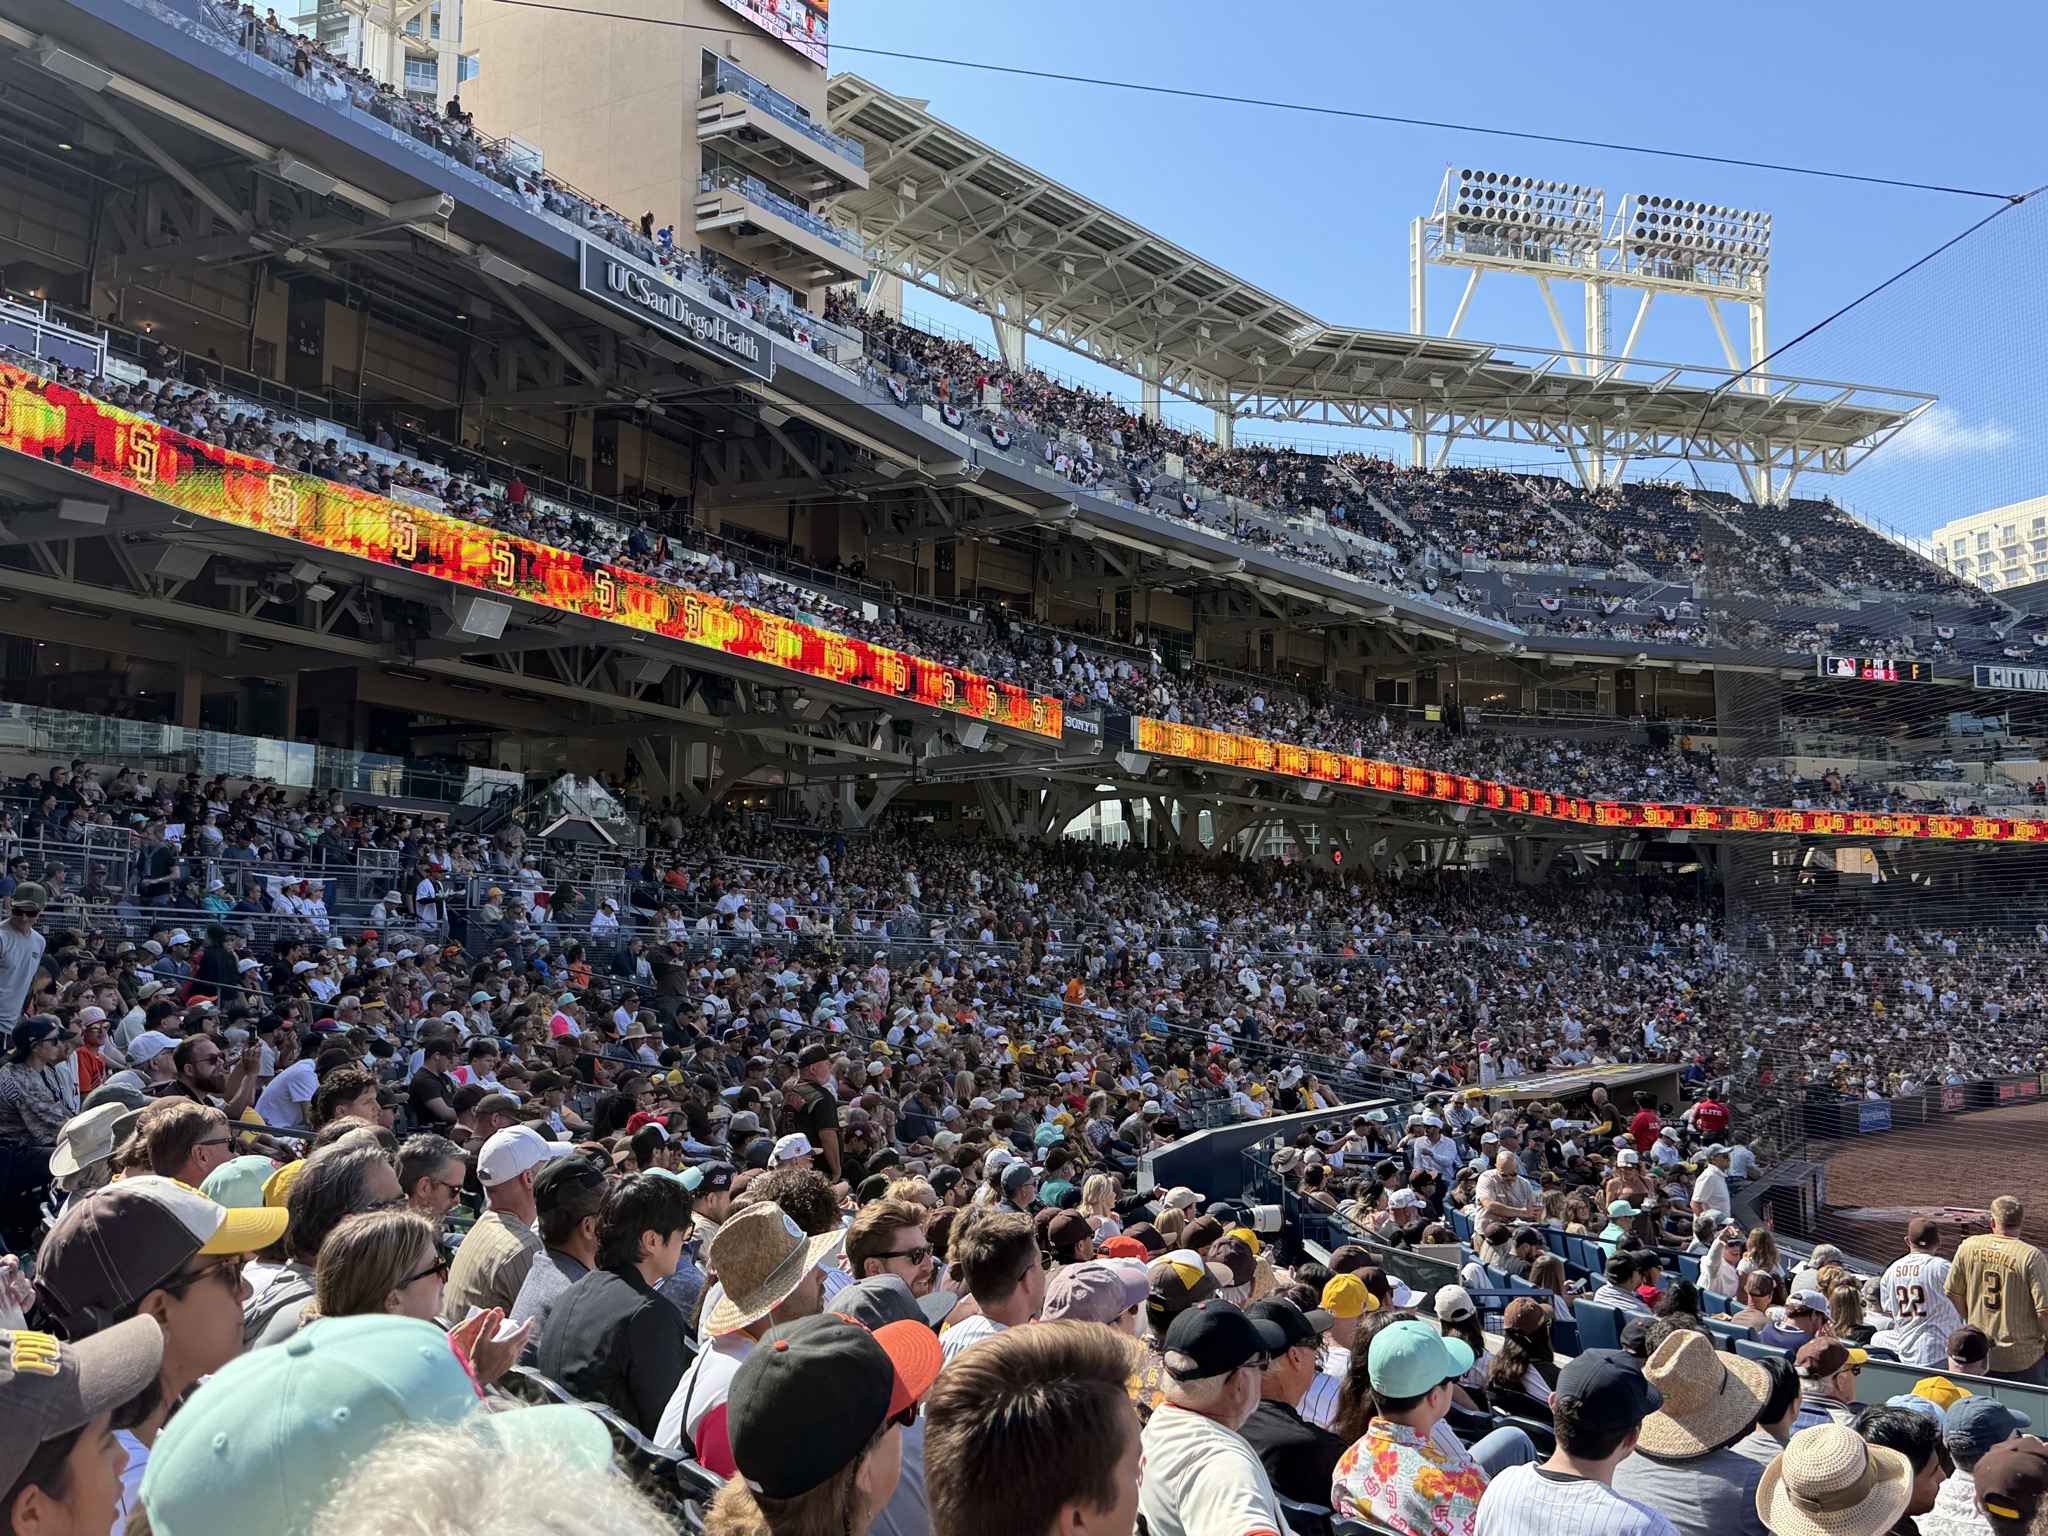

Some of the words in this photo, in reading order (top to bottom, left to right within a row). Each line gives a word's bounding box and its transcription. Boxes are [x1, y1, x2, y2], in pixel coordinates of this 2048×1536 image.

[758, 7, 787, 31] LAUREANO
[712, 315, 759, 362] Health
[1873, 659, 1884, 669] PIT
[1873, 669, 1885, 679] CIN
[1888, 670, 1894, 680] 3
[1912, 664, 1919, 679] F
[1065, 715, 1091, 733] SONY
[1972, 1248, 2017, 1272] MERRILL
[1896, 1264, 1920, 1278] SOTO
[1982, 1269, 2001, 1310] 3
[1896, 1285, 1927, 1317] 22
